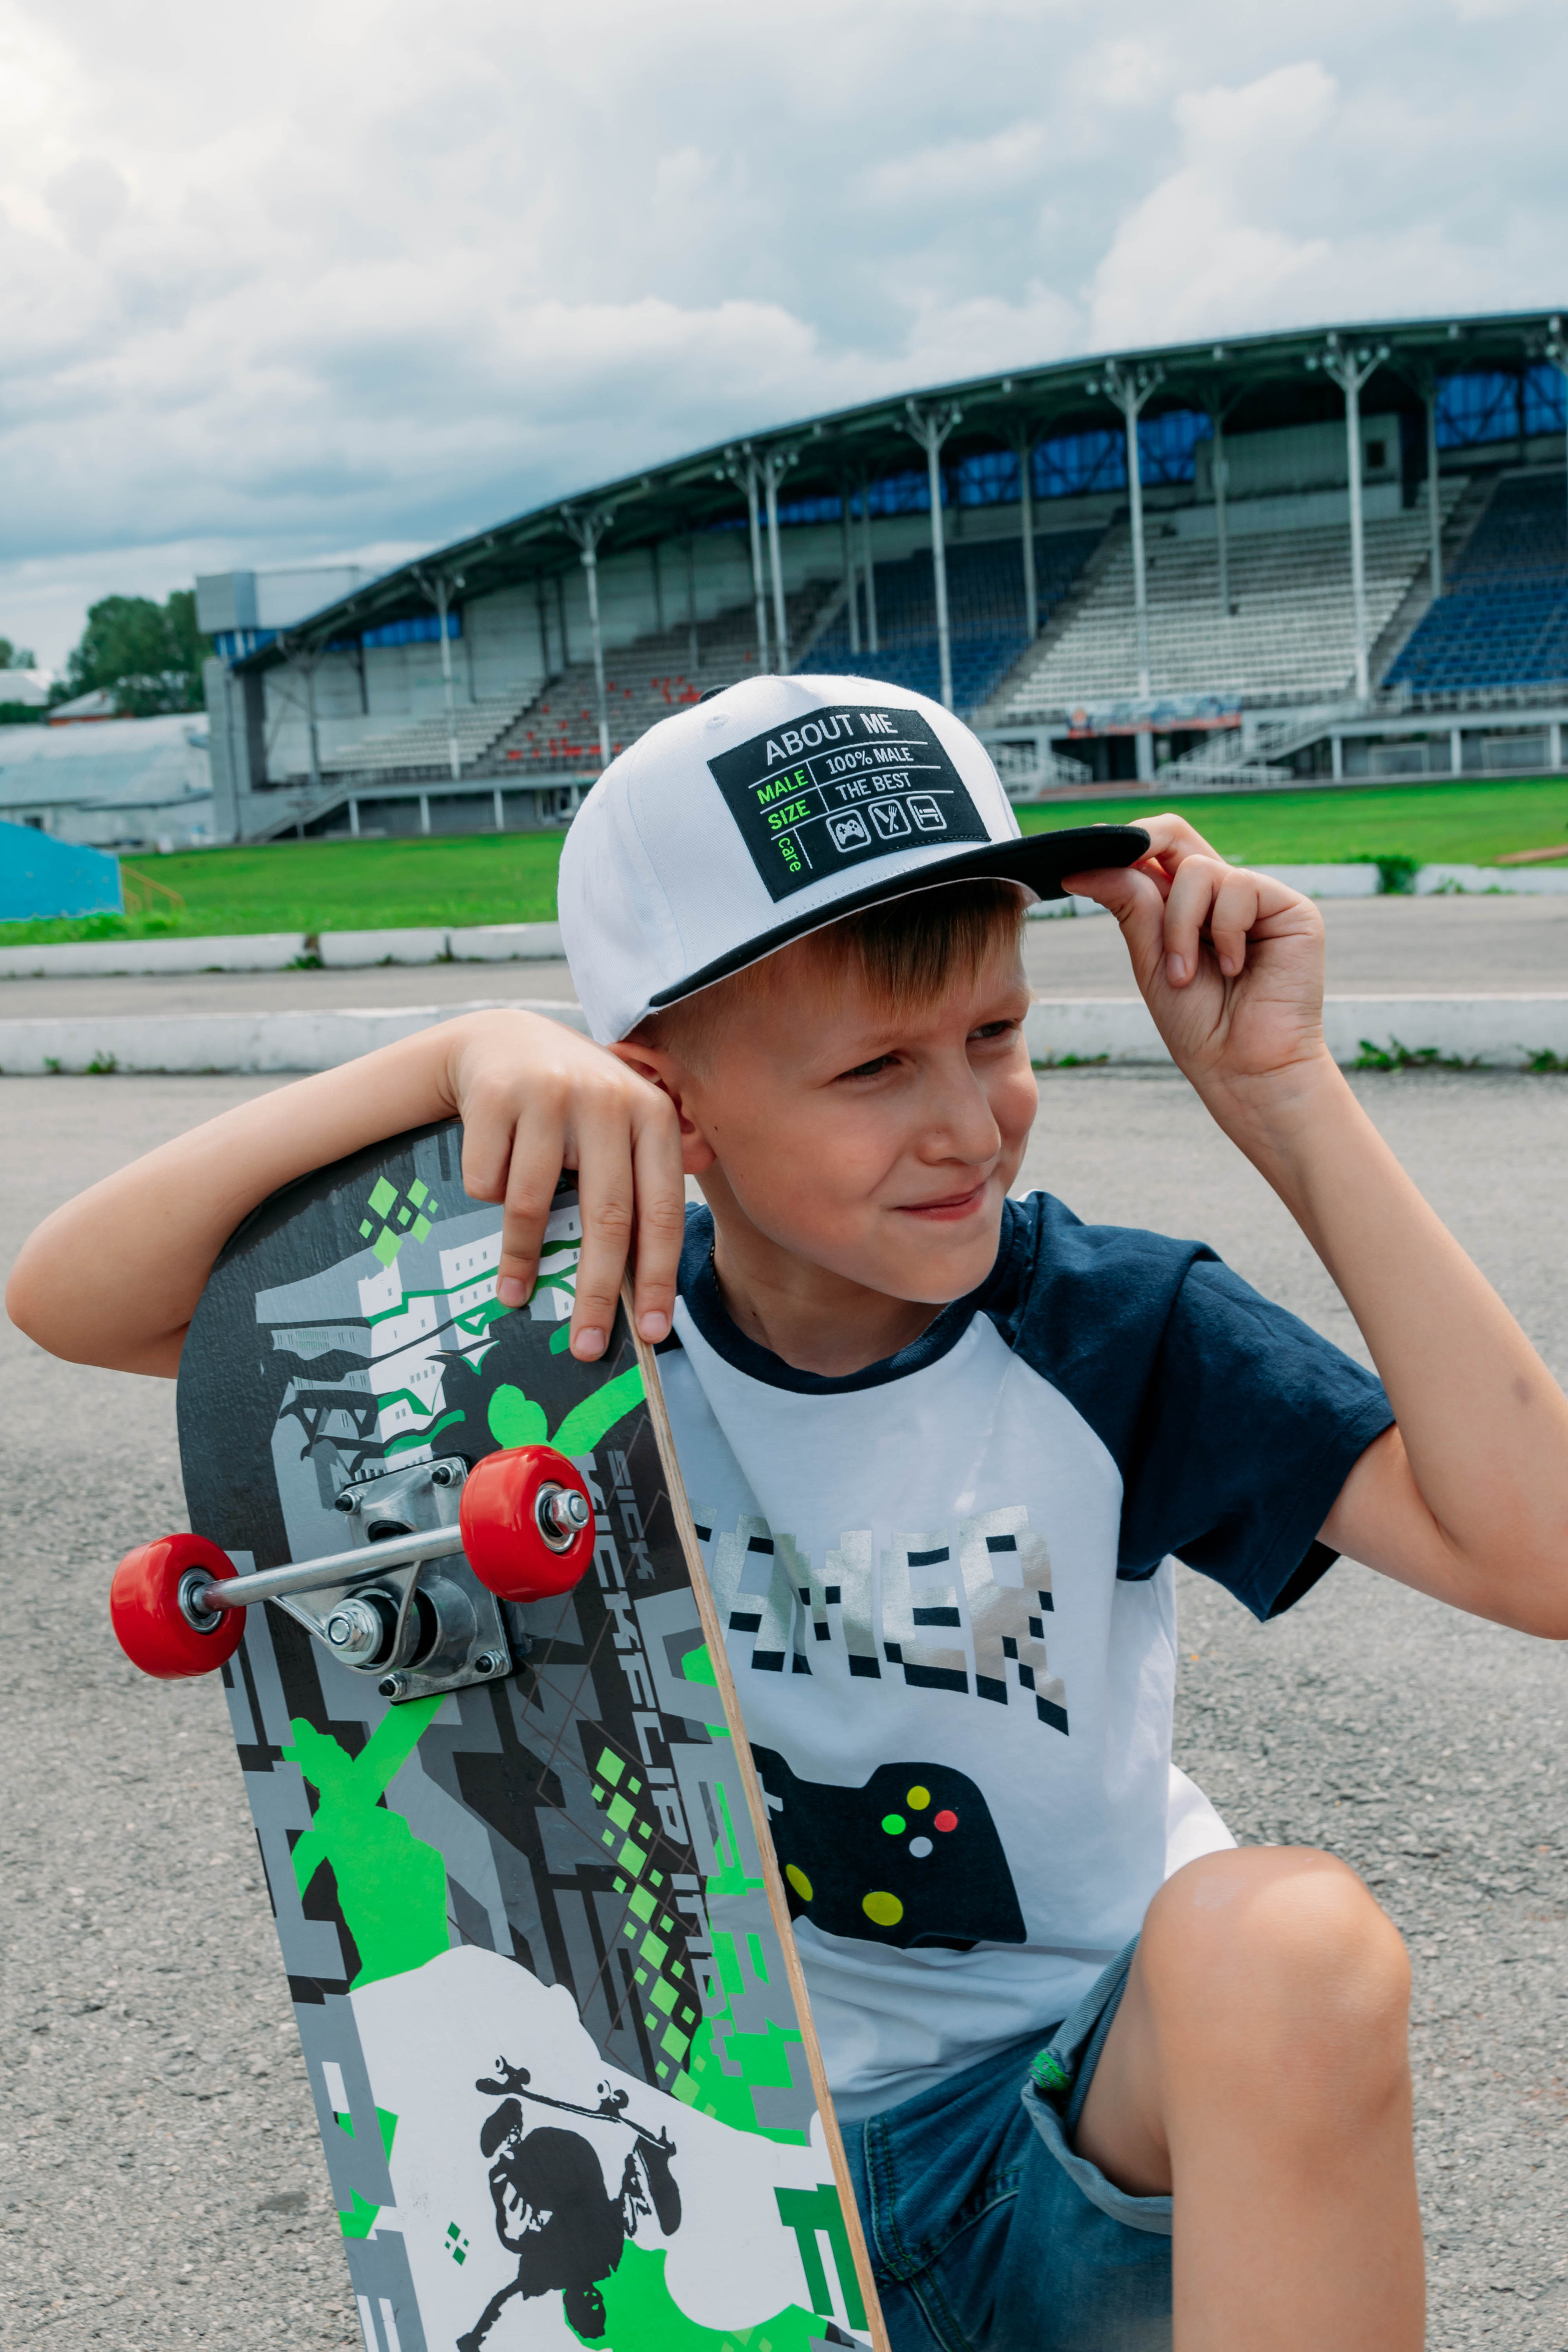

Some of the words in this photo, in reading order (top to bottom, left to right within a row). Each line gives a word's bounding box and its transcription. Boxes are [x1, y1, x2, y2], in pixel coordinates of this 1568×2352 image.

[766, 714, 854, 766] ABOUT
[859, 713, 899, 734] ME
[826, 750, 873, 775] 100%
[873, 747, 914, 763] MALE
[756, 769, 809, 805] MALE
[835, 780, 872, 801] THE
[874, 772, 913, 792] BEST
[767, 799, 811, 830] SIZE
[778, 837, 802, 873] care
[606, 1450, 656, 1580] SICK
[688, 1499, 1069, 1736] AMER
